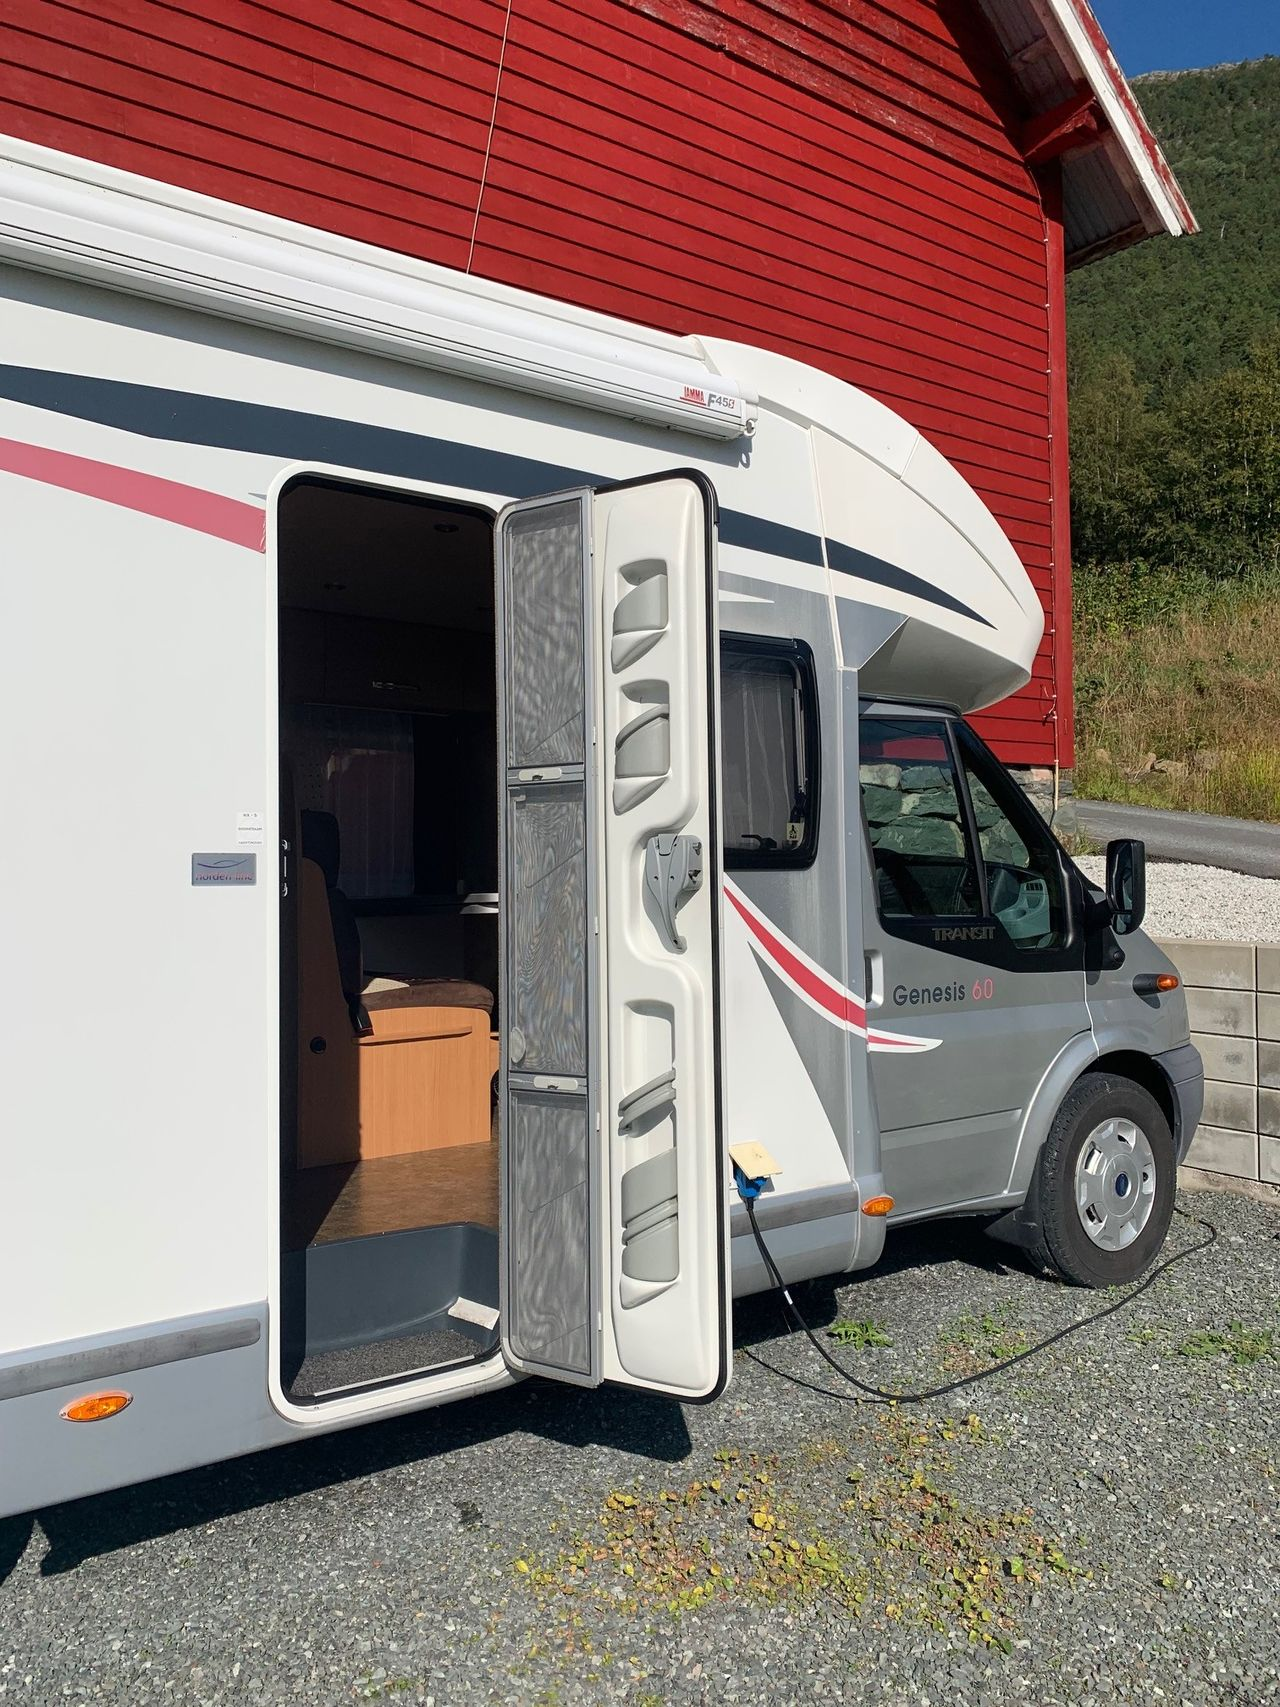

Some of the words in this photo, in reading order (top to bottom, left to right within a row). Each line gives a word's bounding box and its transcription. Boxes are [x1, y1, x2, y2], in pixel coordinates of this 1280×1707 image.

[932, 926, 996, 941] TRANSIT
[893, 981, 966, 1006] Genesis
[972, 978, 993, 1000] 60
